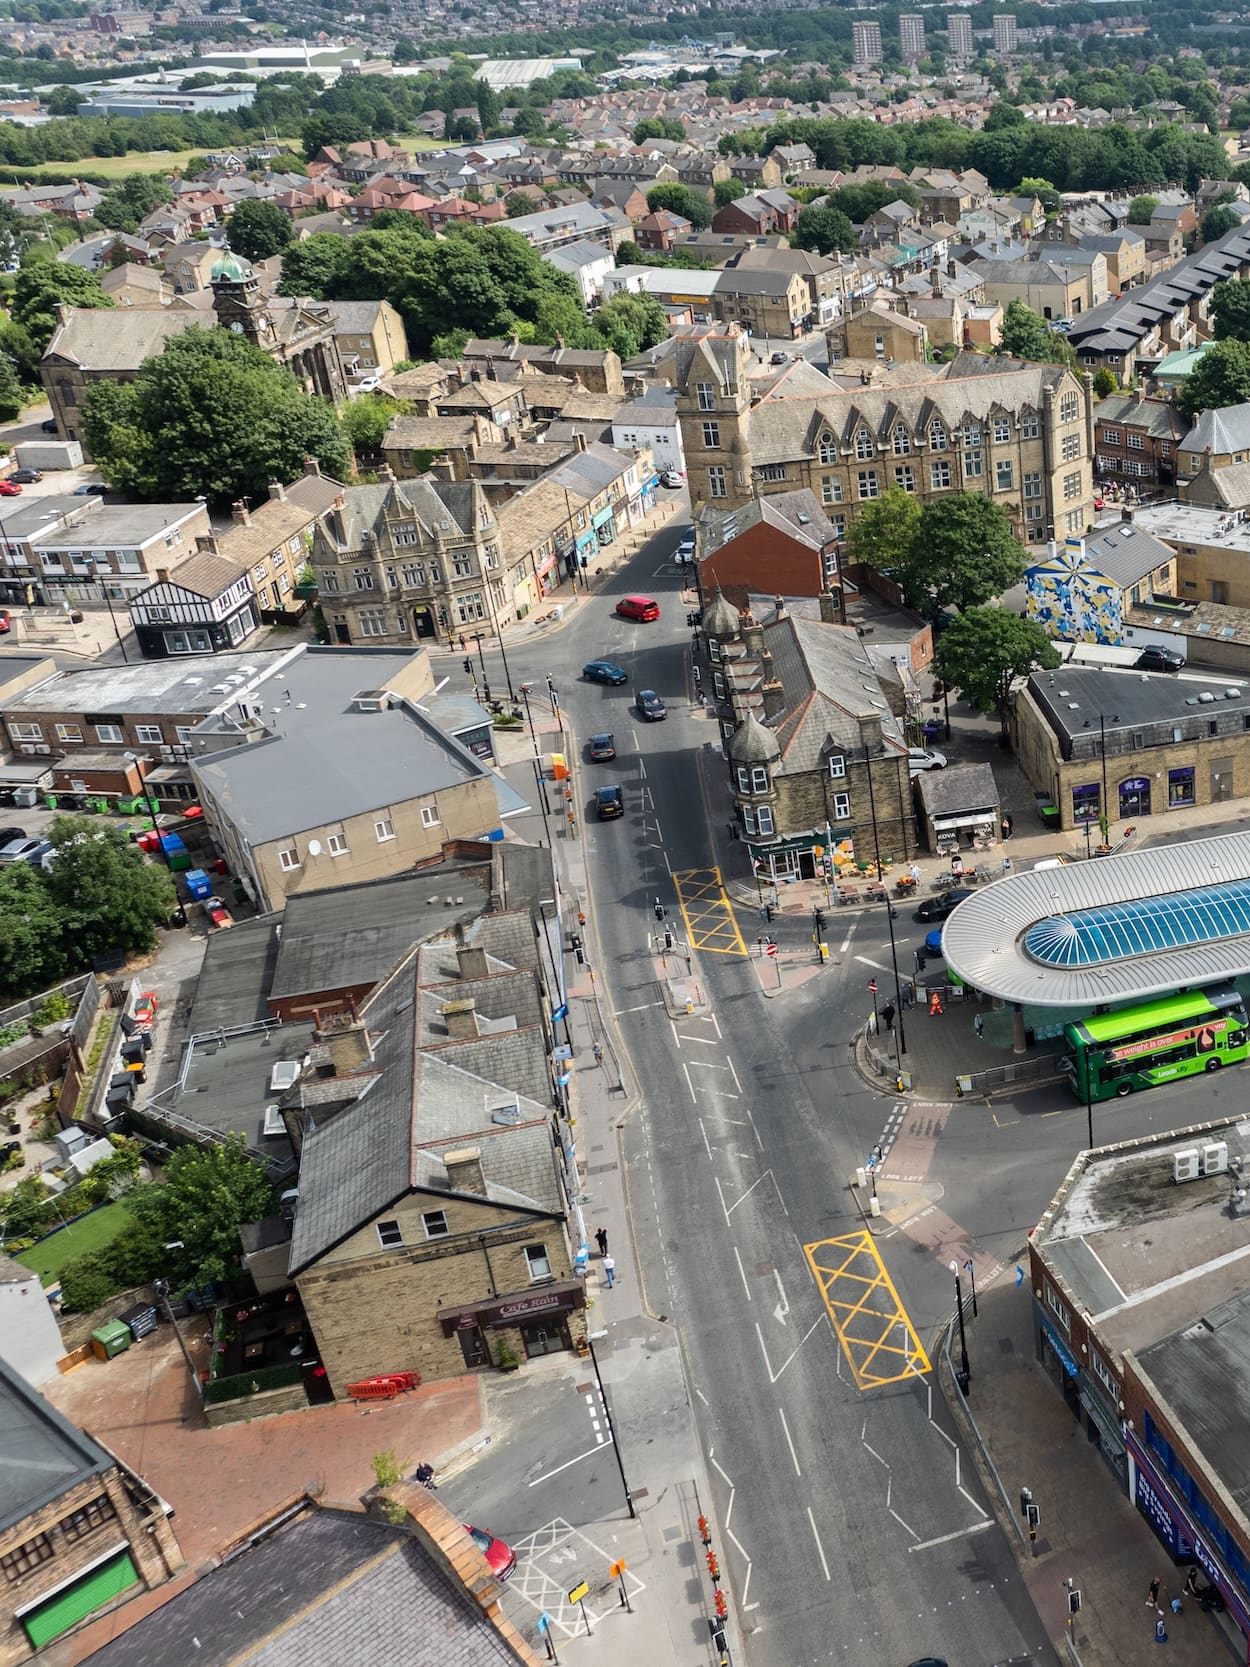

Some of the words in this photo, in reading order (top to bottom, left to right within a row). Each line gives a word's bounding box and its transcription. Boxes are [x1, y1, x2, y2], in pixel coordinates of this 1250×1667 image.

[937, 832, 957, 840] KOVA
[1123, 1041, 1149, 1056] weight
[1157, 1037, 1173, 1047] over
[881, 1173, 902, 1181] LOOK
[500, 1303, 528, 1315] Cafe
